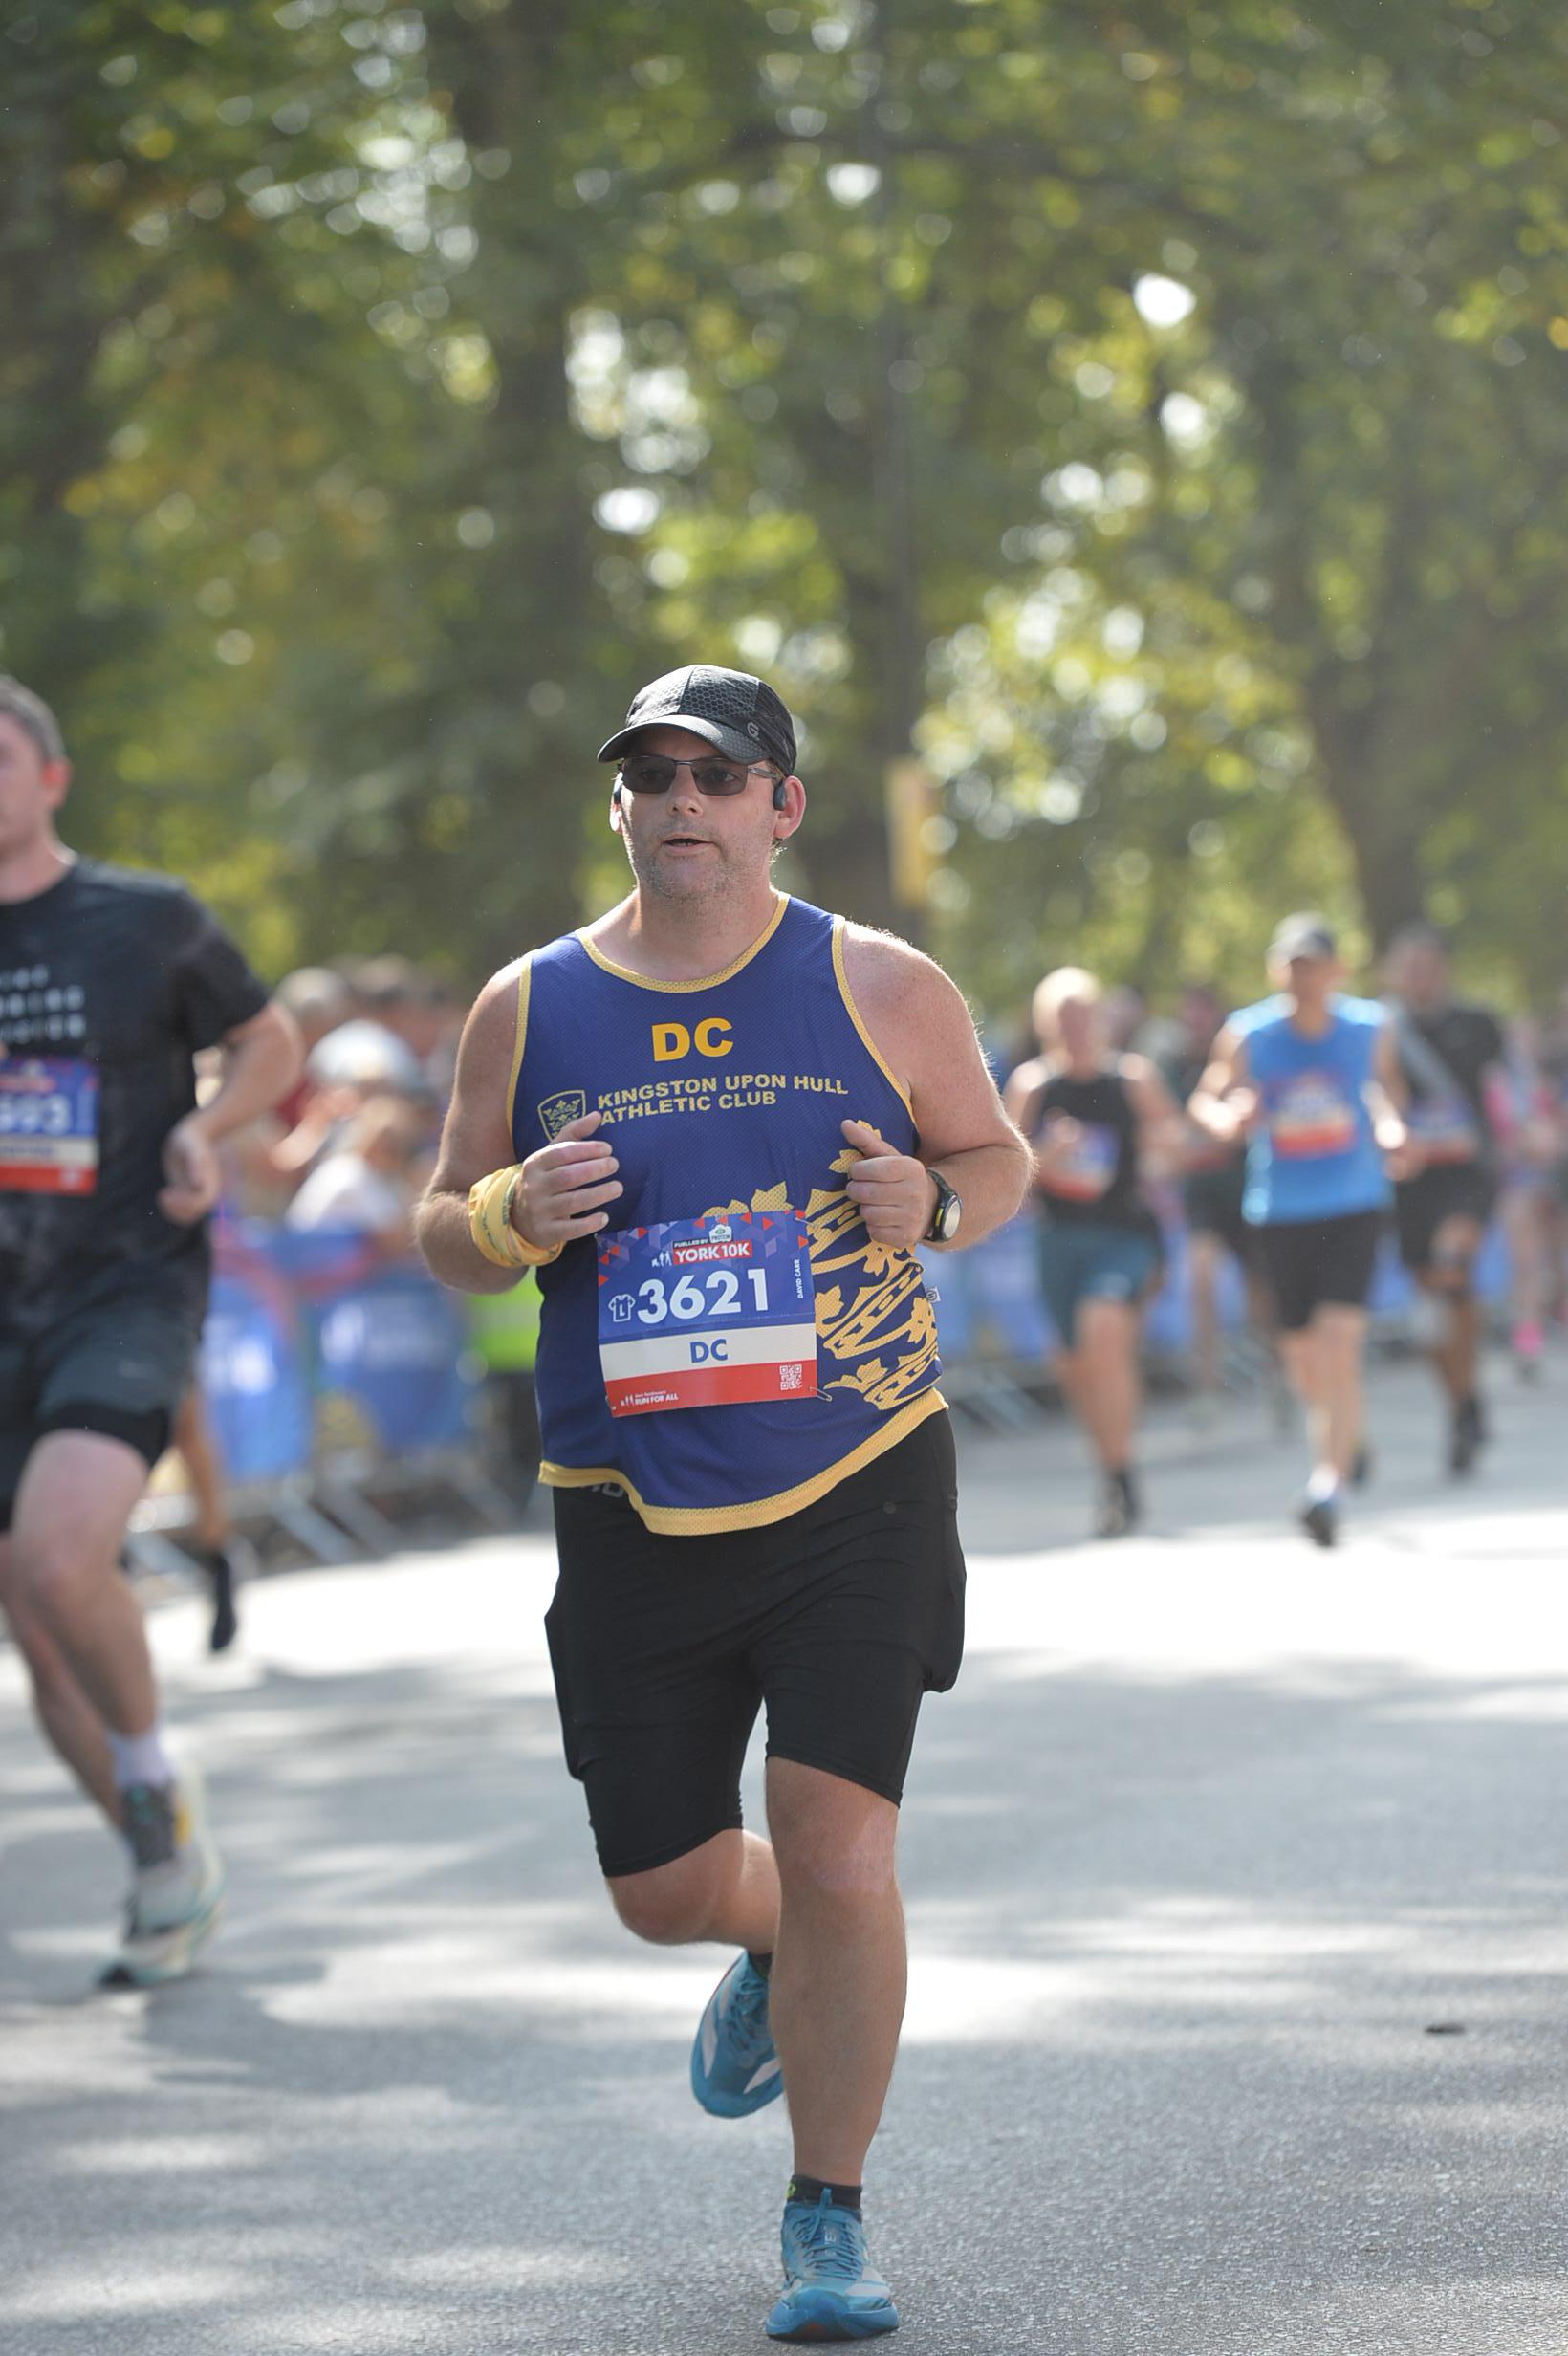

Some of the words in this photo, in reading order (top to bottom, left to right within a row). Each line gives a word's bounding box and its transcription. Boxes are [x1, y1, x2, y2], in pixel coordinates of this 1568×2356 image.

[651, 1017, 734, 1062] DC
[598, 1077, 717, 1109] KINGSTON
[724, 1074, 787, 1091] UPON
[794, 1075, 849, 1095] HULL
[599, 1096, 711, 1126] ATHLETIC
[718, 1091, 776, 1109] CLUB
[675, 1245, 720, 1263] YORK
[721, 1243, 750, 1257] 10K
[637, 1268, 769, 1324] 3621
[795, 1278, 804, 1299] DAVID
[619, 1303, 625, 1317] L
[689, 1339, 729, 1363] DC
[665, 1392, 679, 1401] ALL
